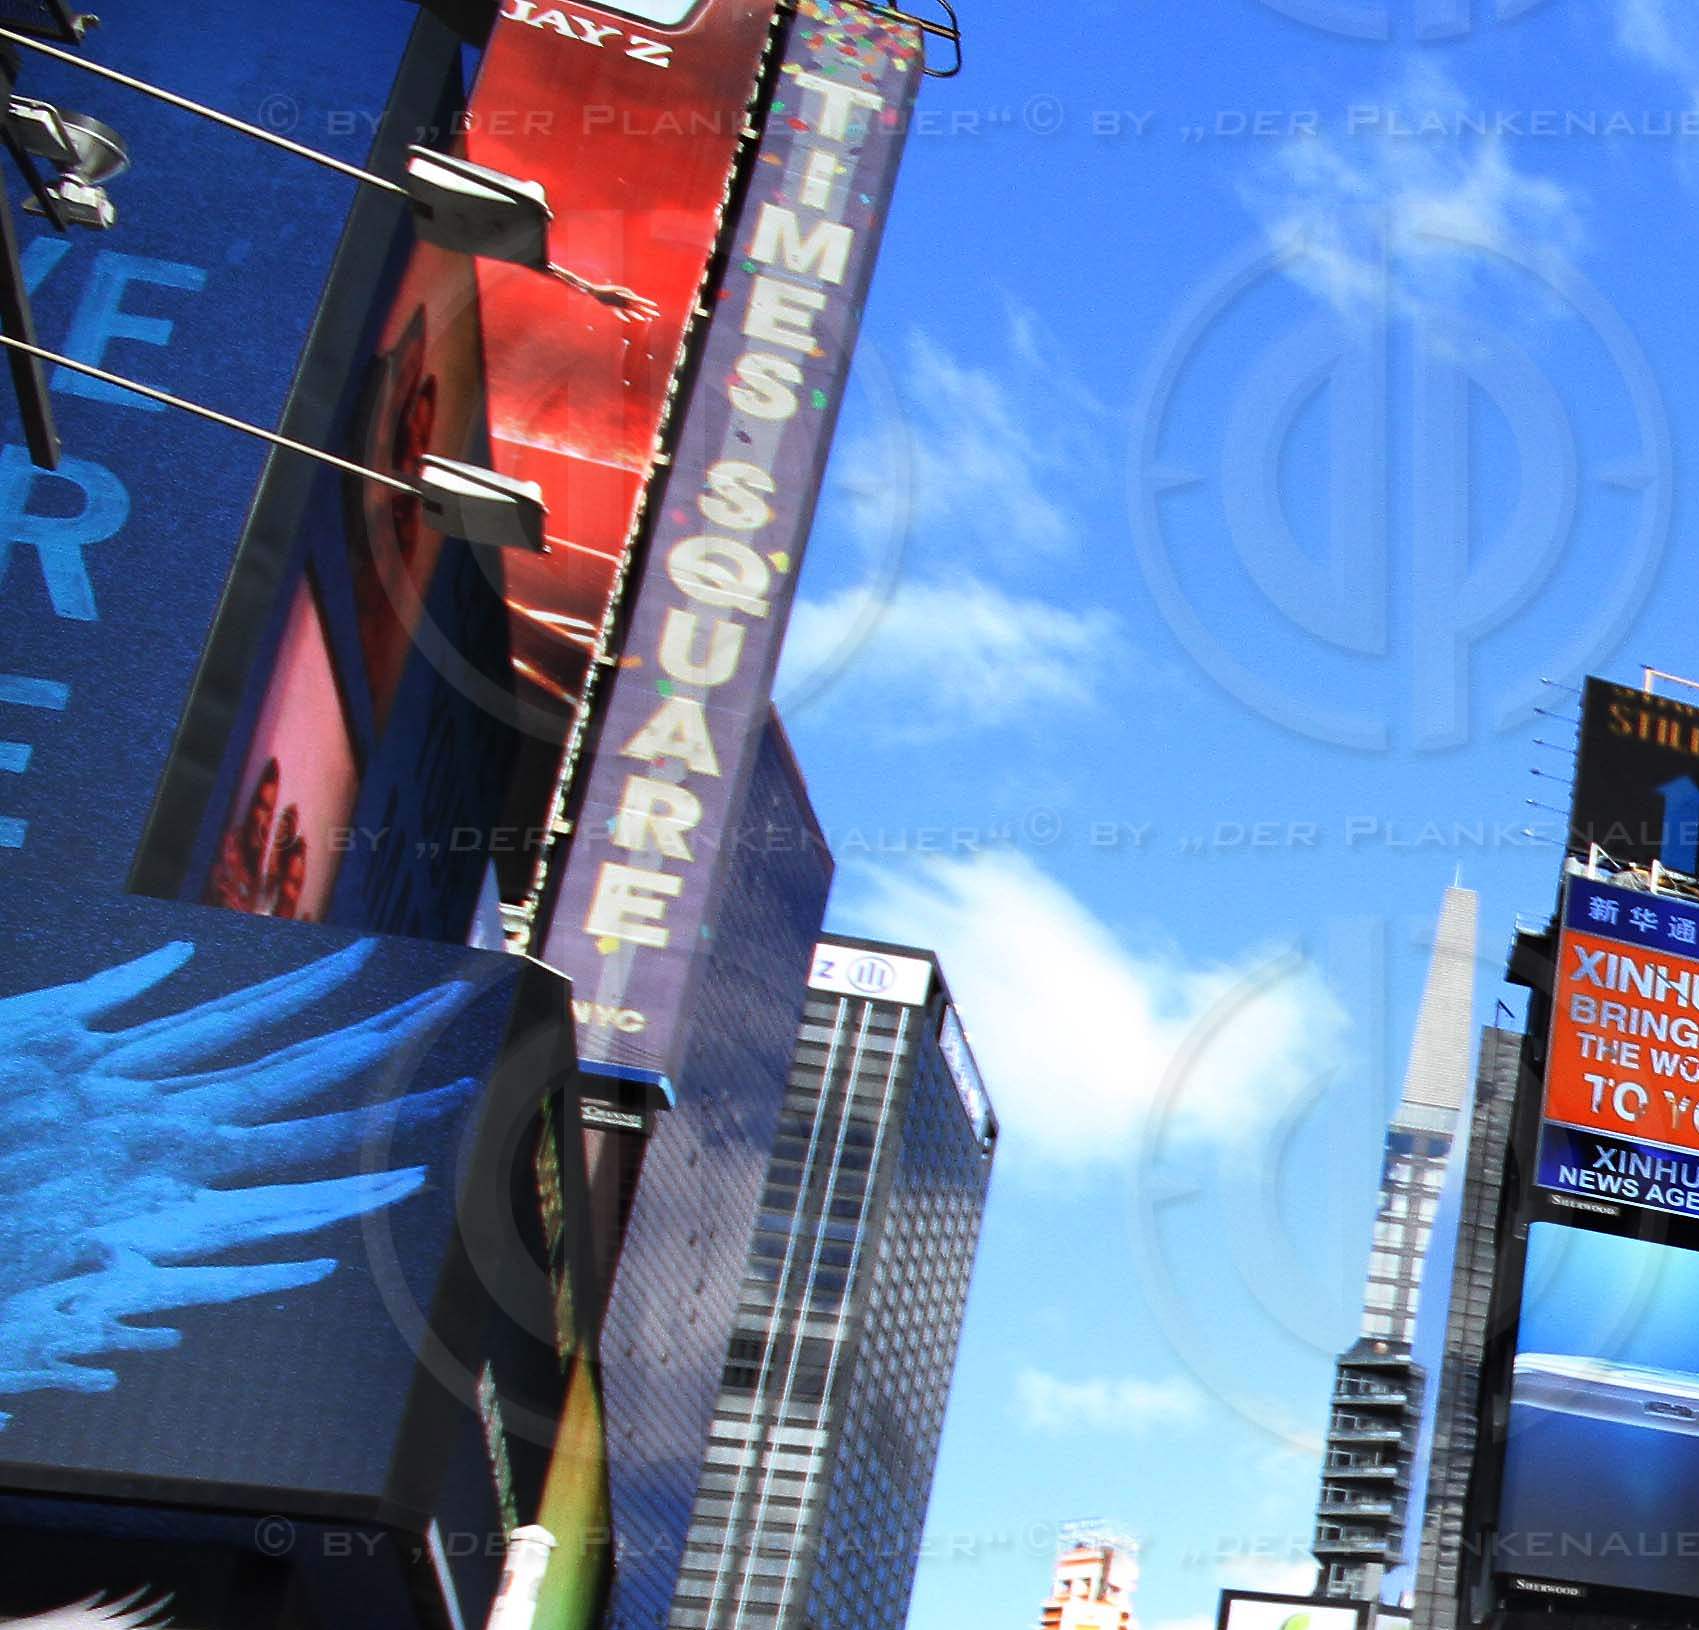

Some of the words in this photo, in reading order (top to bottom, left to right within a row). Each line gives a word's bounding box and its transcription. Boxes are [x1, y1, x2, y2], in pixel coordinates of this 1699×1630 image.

[501, 0, 622, 48] JAY
[624, 35, 673, 69] Z
[728, 71, 884, 421] TIMES
[583, 460, 780, 949] SQUARE
[1576, 1031, 1642, 1072] THE
[1582, 1073, 1650, 1123] TO
[1557, 1164, 1640, 1201] NEWS
